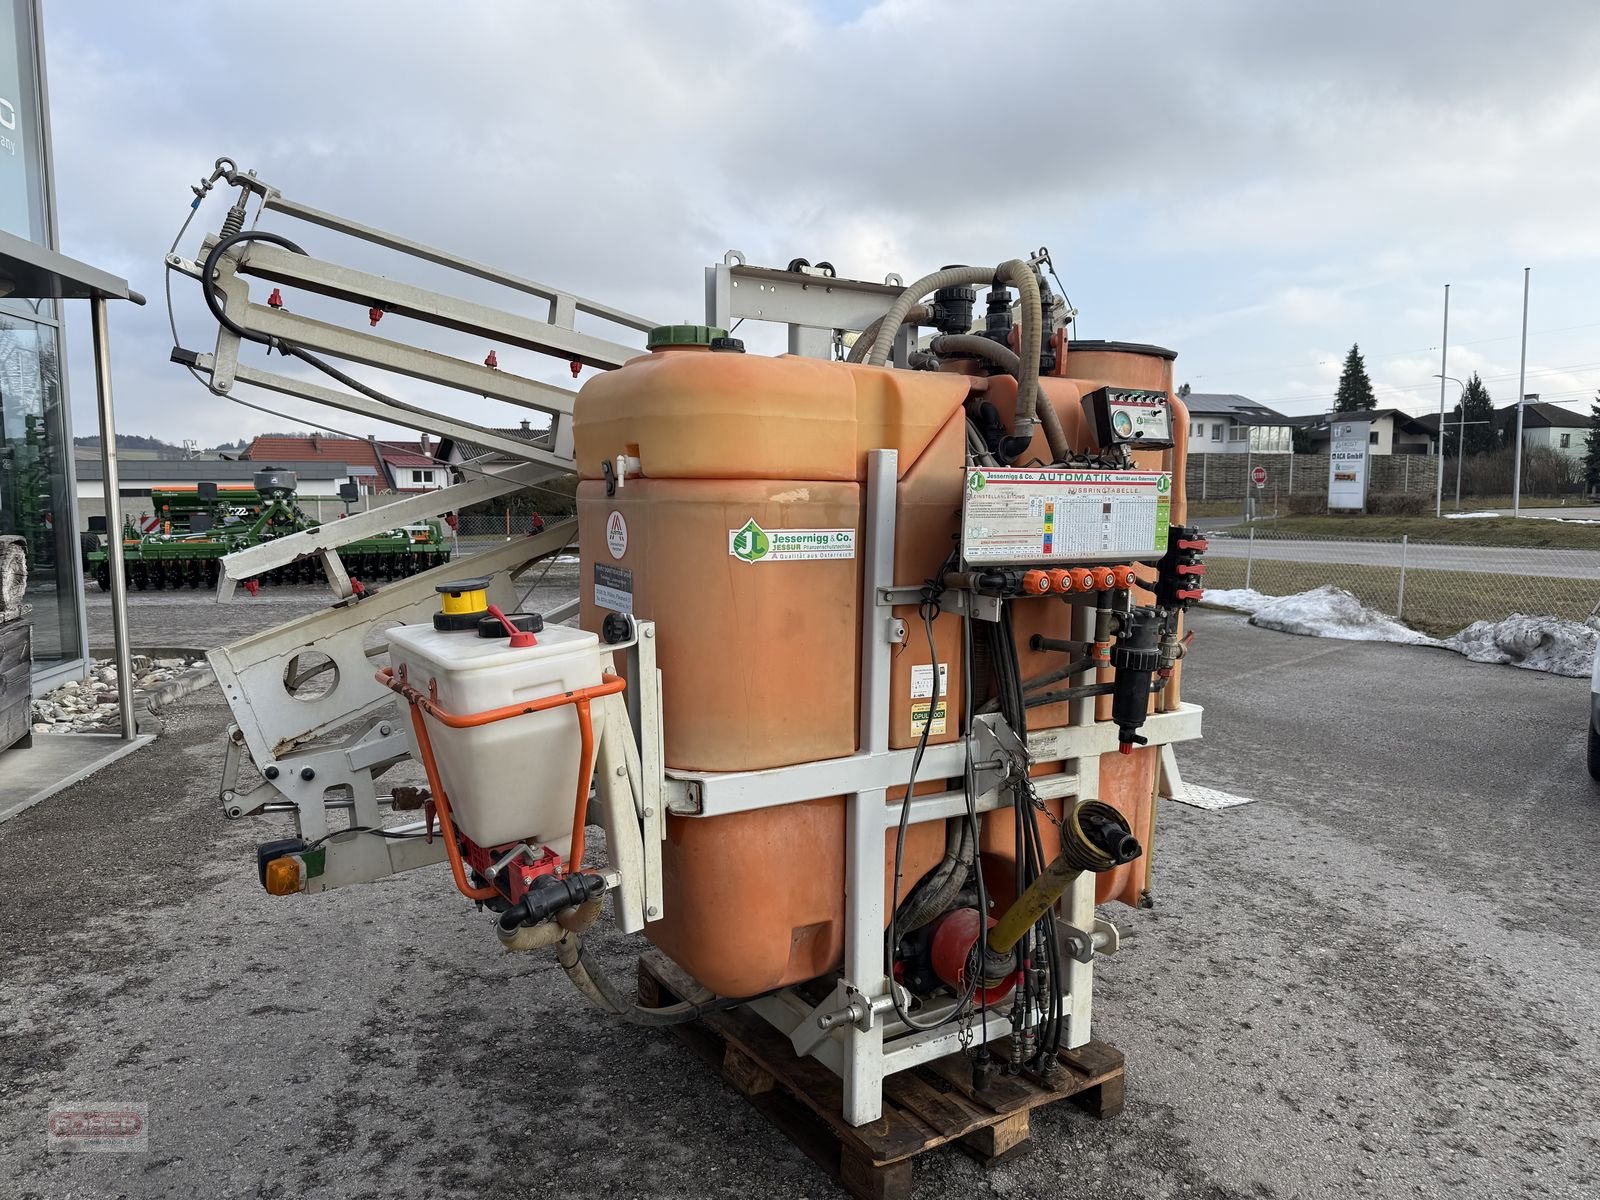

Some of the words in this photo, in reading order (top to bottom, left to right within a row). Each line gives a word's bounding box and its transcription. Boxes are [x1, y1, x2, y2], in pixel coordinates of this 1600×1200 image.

[987, 472, 1018, 480] Jessernigg
[1039, 473, 1112, 482] AUTOMATIK
[772, 533, 829, 545] Jessernigg
[836, 532, 852, 541] Co.
[772, 543, 801, 551] JESSUR
